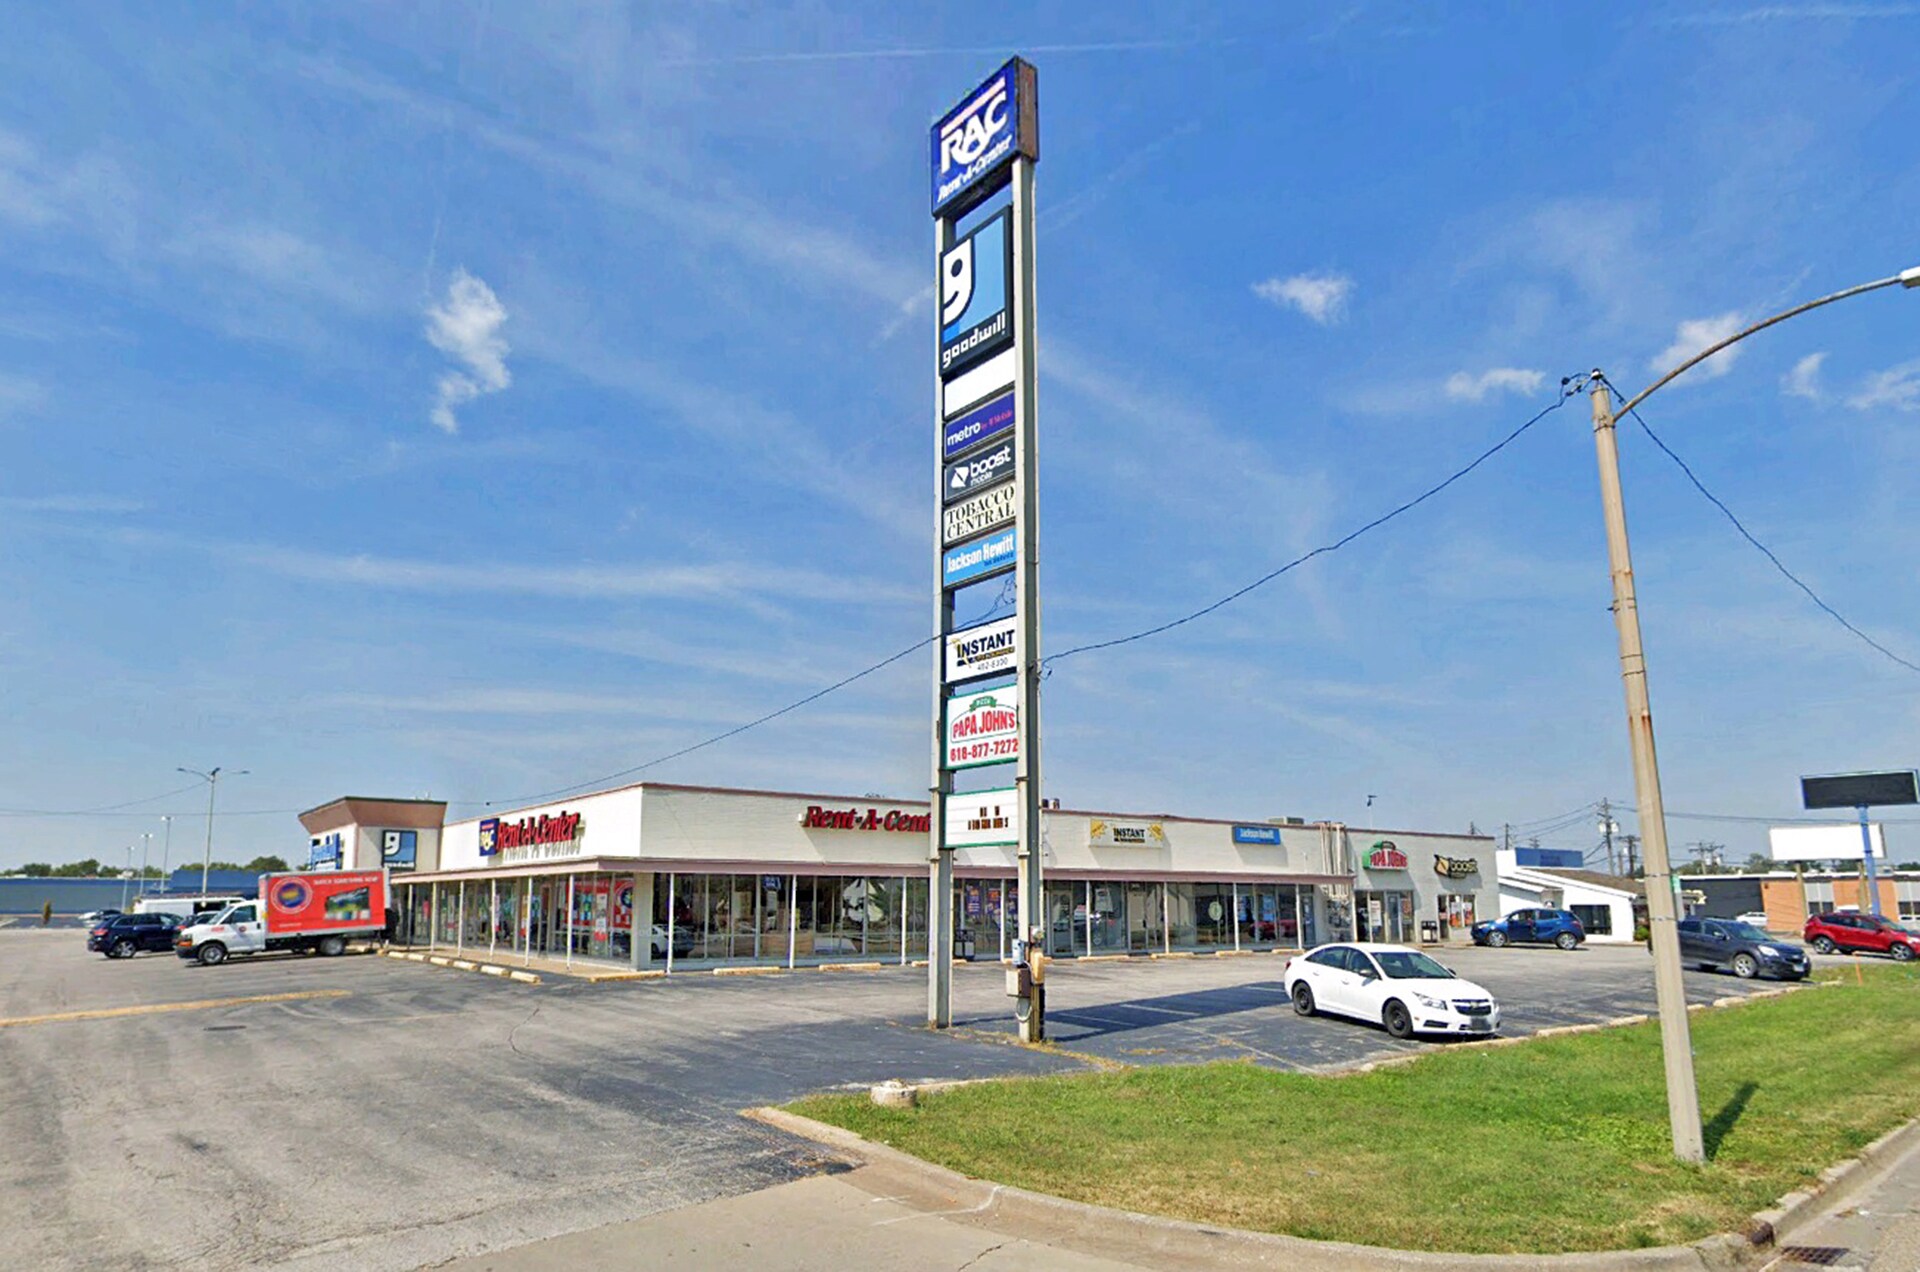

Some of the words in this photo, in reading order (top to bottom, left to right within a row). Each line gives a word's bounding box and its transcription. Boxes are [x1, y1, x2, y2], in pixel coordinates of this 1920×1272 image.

[941, 90, 1007, 174] RAC
[943, 311, 1005, 368] goodwill
[947, 422, 980, 446] metro
[970, 446, 1011, 477] boost
[947, 486, 1015, 524] TOBACCO
[947, 503, 1015, 539] CENTRAL
[947, 548, 982, 573] Jackson
[983, 534, 1014, 560] Hewitt
[957, 629, 1015, 658] INSTANT
[953, 714, 977, 739] PAPA
[979, 710, 1015, 734] JOHN'S
[950, 738, 1018, 762] 618-877-7272
[802, 806, 931, 832] Rent-A-Cent
[1113, 827, 1145, 838] INSTANT
